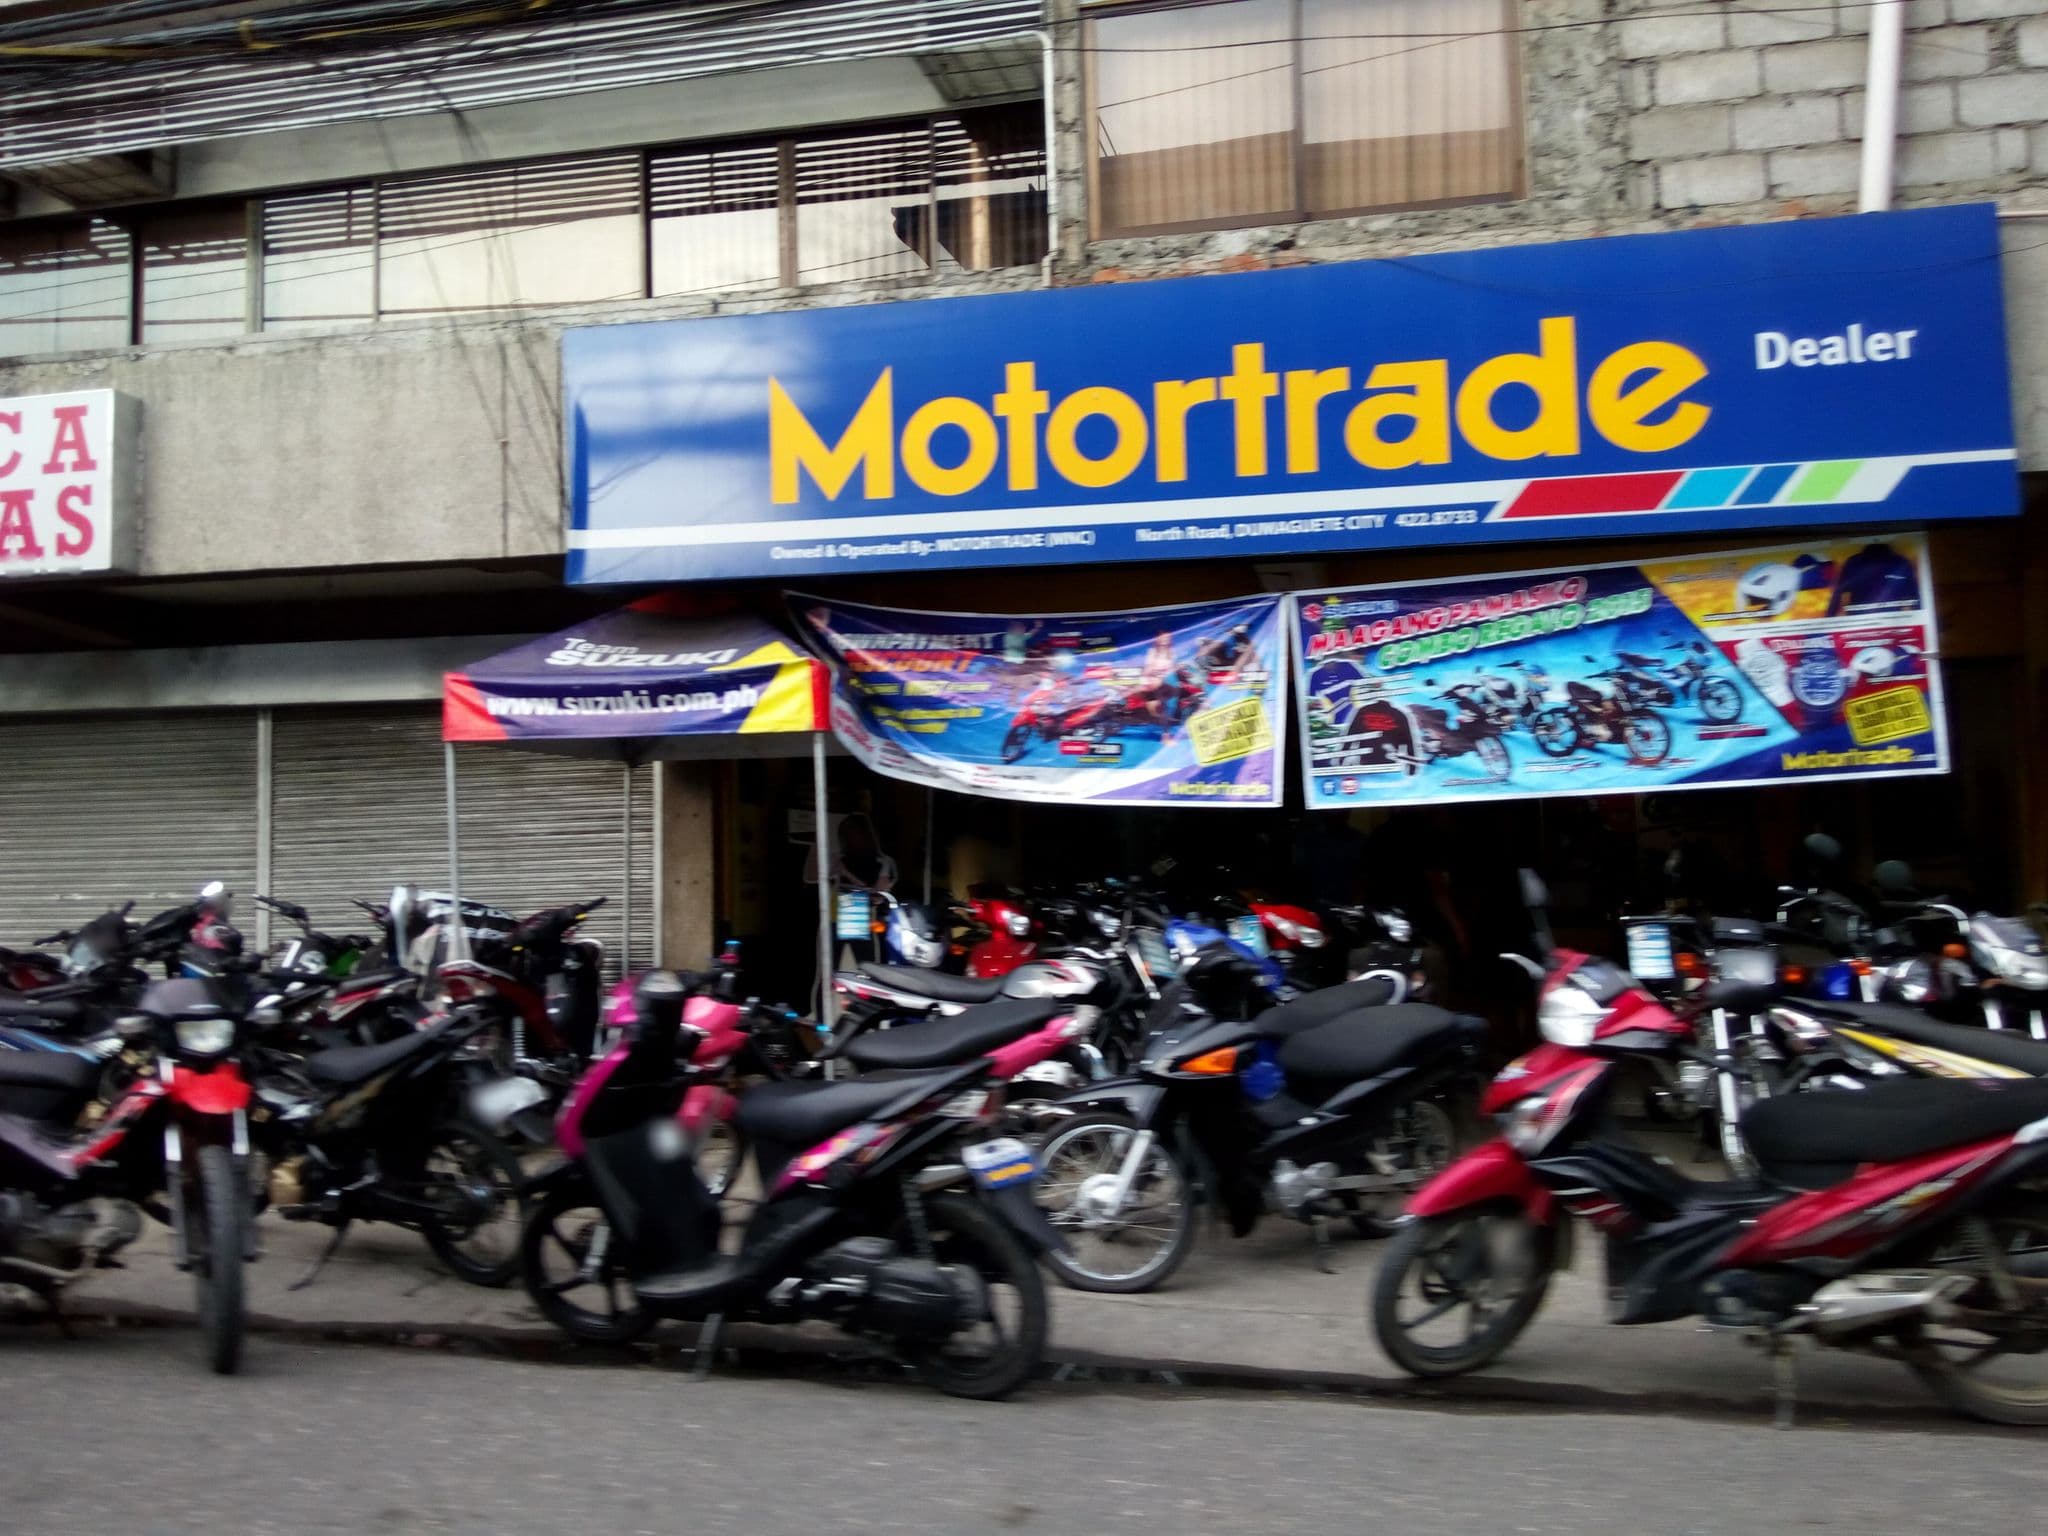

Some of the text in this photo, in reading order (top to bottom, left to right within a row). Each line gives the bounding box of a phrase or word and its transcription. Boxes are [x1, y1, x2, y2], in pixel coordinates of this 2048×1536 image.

[1754, 324, 1917, 370] Dealer
[768, 316, 1711, 504] Motortrade
[1136, 526, 1183, 542] North
[1234, 516, 1344, 537] DUMAGUETE
[1345, 514, 1387, 529] CITY
[770, 545, 823, 559] Owned
[838, 541, 908, 559] Operated
[935, 533, 1045, 551] MOTORTRADE
[1305, 576, 1588, 660] MAAGANG PAMASKO
[545, 649, 738, 667] SUZUKI
[564, 638, 640, 655] Team
[486, 684, 757, 717] www.suzuki.com.ph
[1782, 746, 1914, 770] Motortrade
